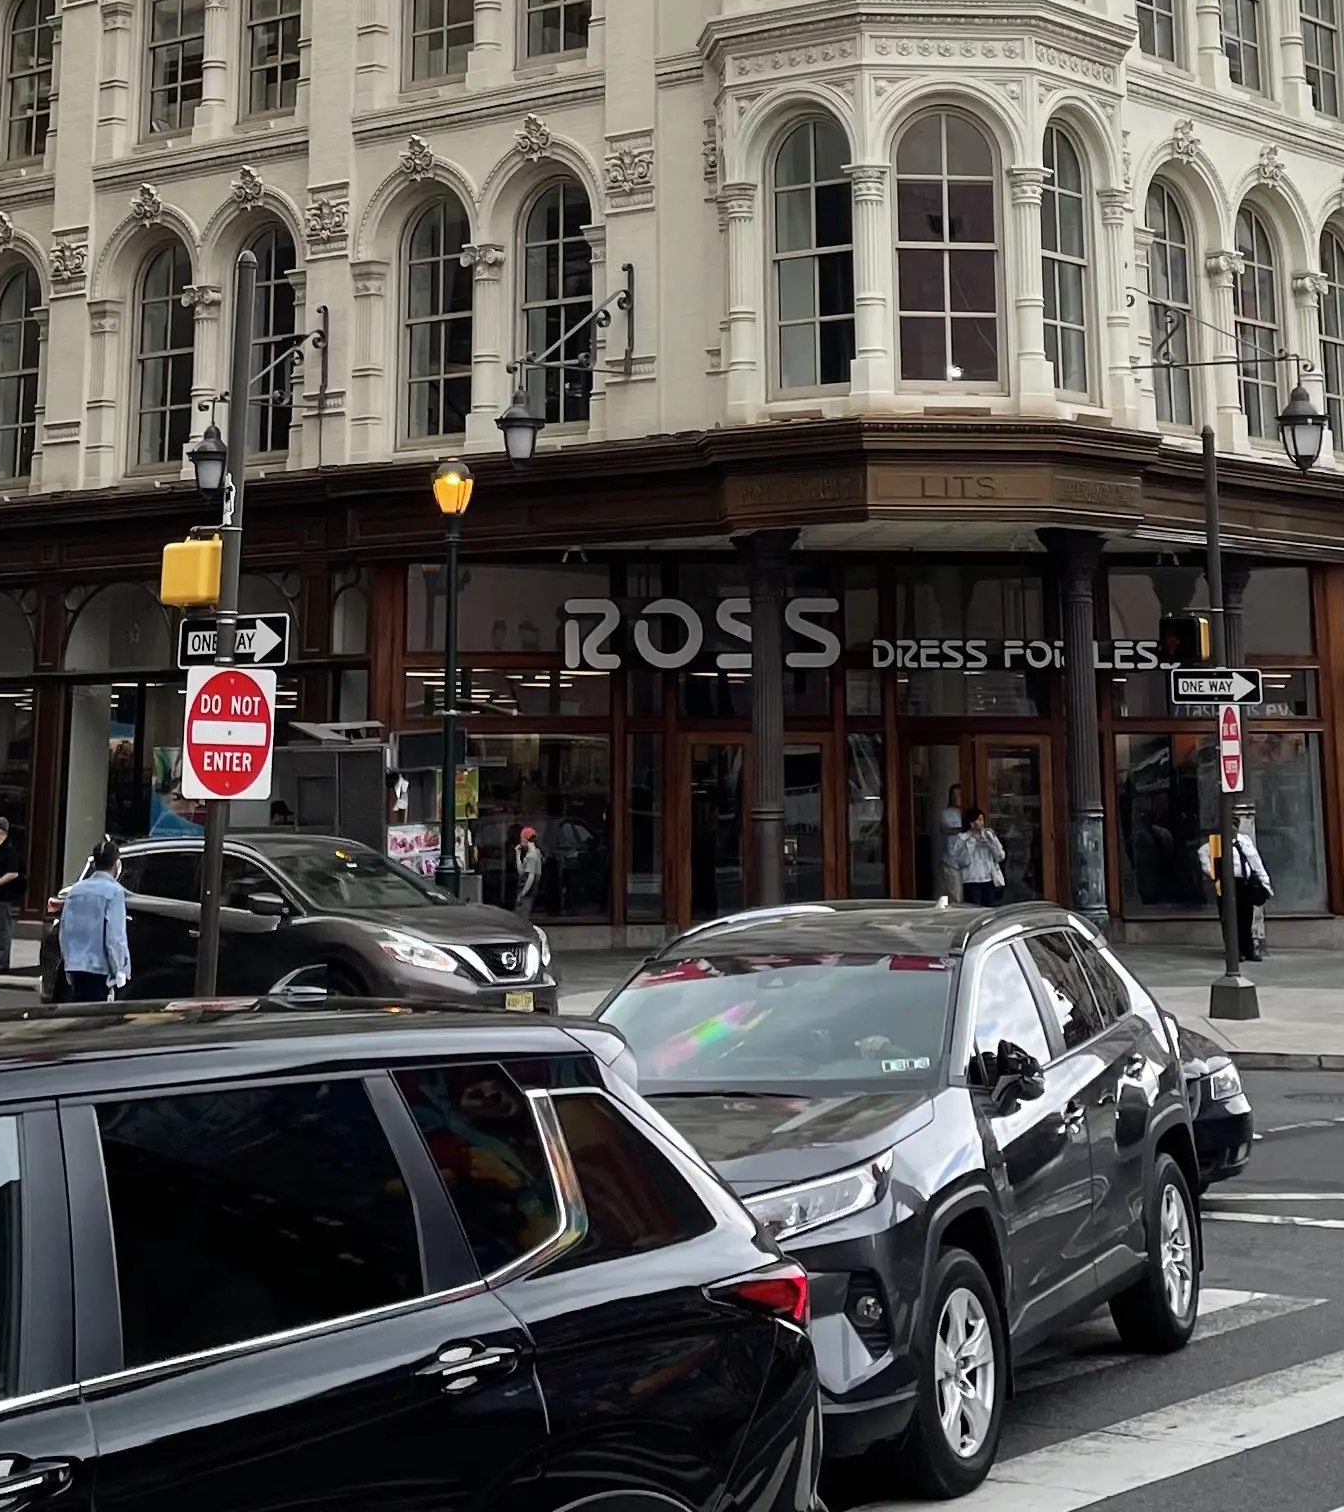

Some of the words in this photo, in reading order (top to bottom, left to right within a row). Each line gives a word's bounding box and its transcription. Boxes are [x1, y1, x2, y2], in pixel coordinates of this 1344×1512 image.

[920, 476, 995, 499] LITS
[236, 631, 256, 651] AY
[565, 598, 841, 669] ROSS
[872, 640, 988, 668] DRESS
[1093, 640, 1181, 669] LES
[1181, 680, 1205, 693] ONE
[1208, 680, 1233, 693] WAY
[200, 694, 222, 715] DO
[230, 695, 261, 716] NOT
[203, 750, 252, 772] ENTER
